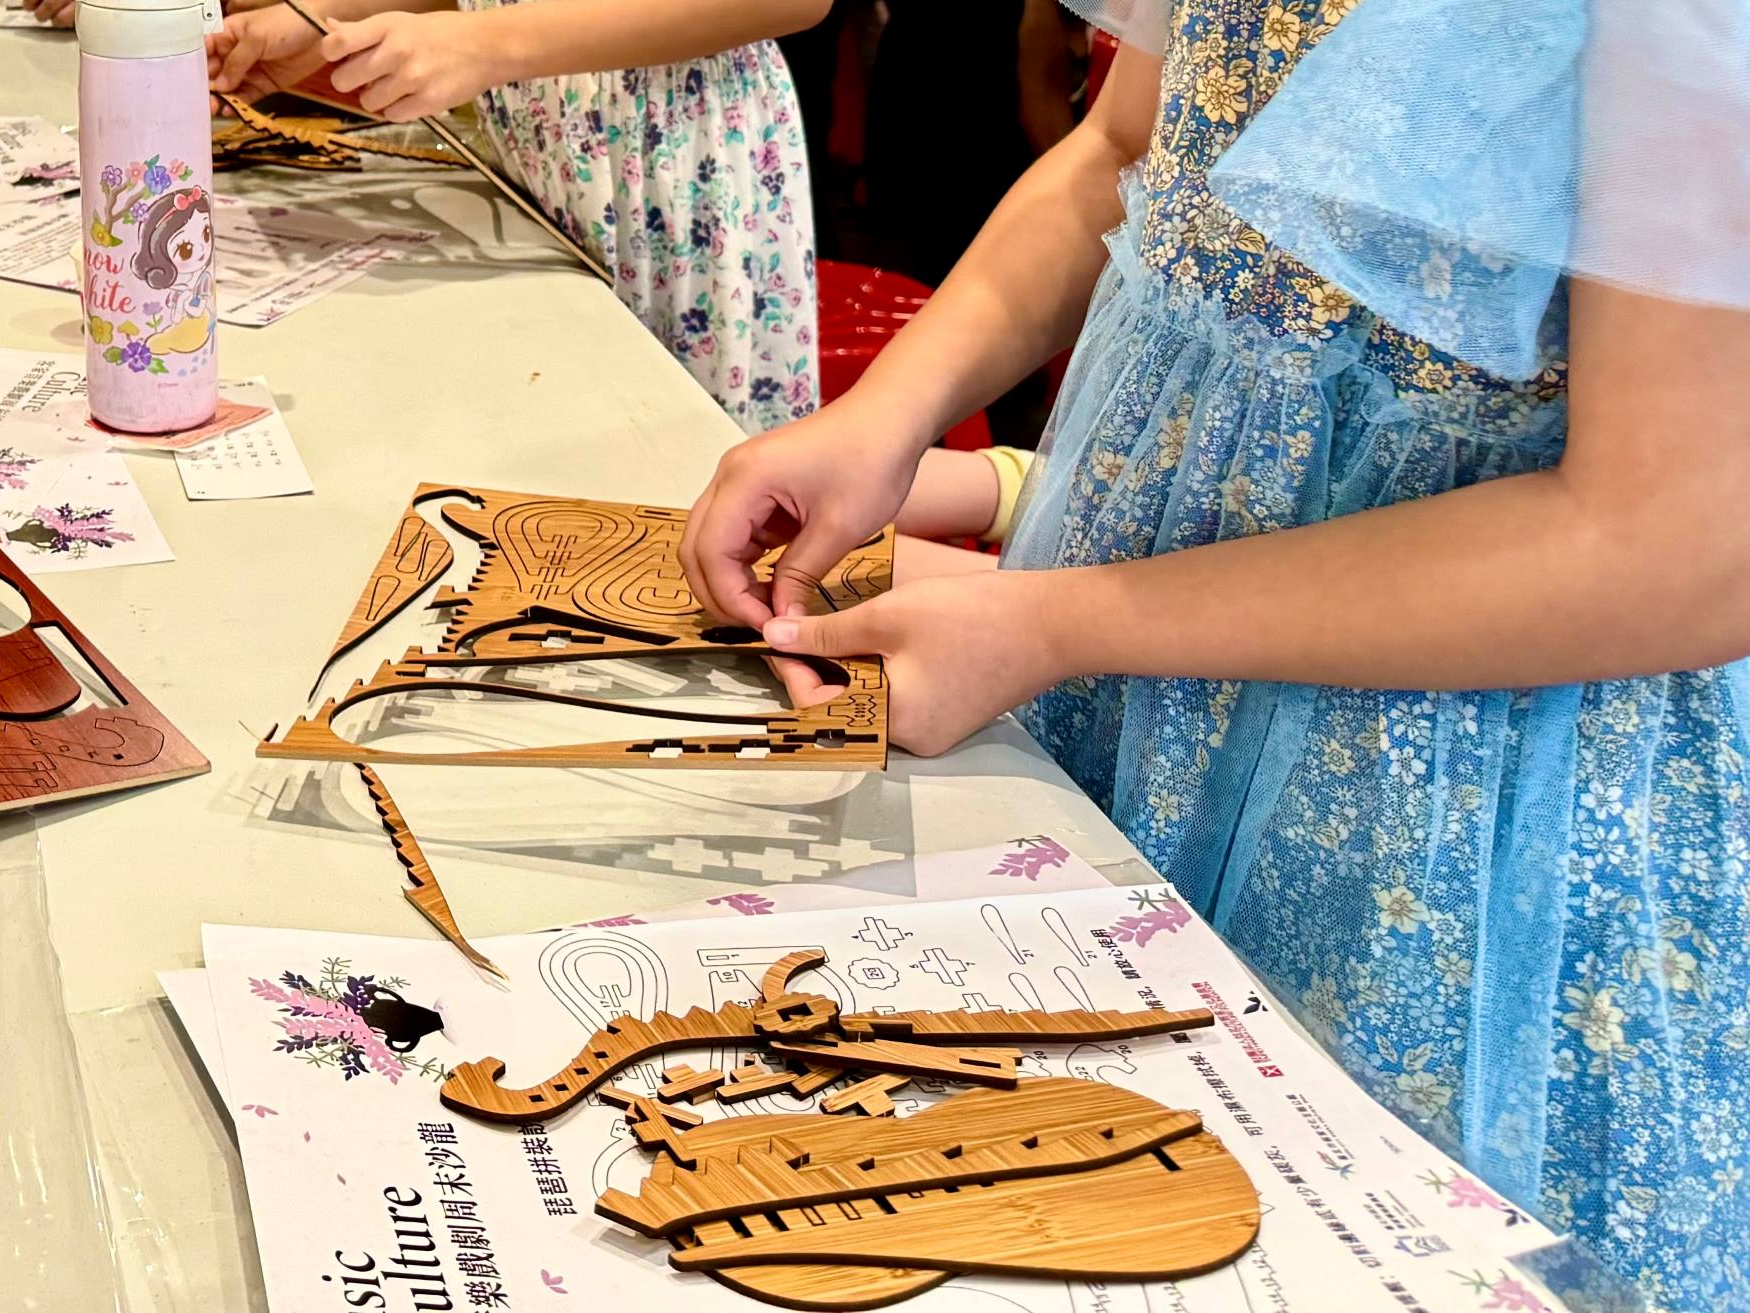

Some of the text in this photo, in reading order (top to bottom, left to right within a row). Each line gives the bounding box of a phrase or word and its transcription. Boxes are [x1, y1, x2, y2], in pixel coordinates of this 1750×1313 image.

[84, 246, 125, 276] now
[86, 274, 136, 314] hite
[22, 371, 81, 413] Culture
[321, 1249, 387, 1313] sic
